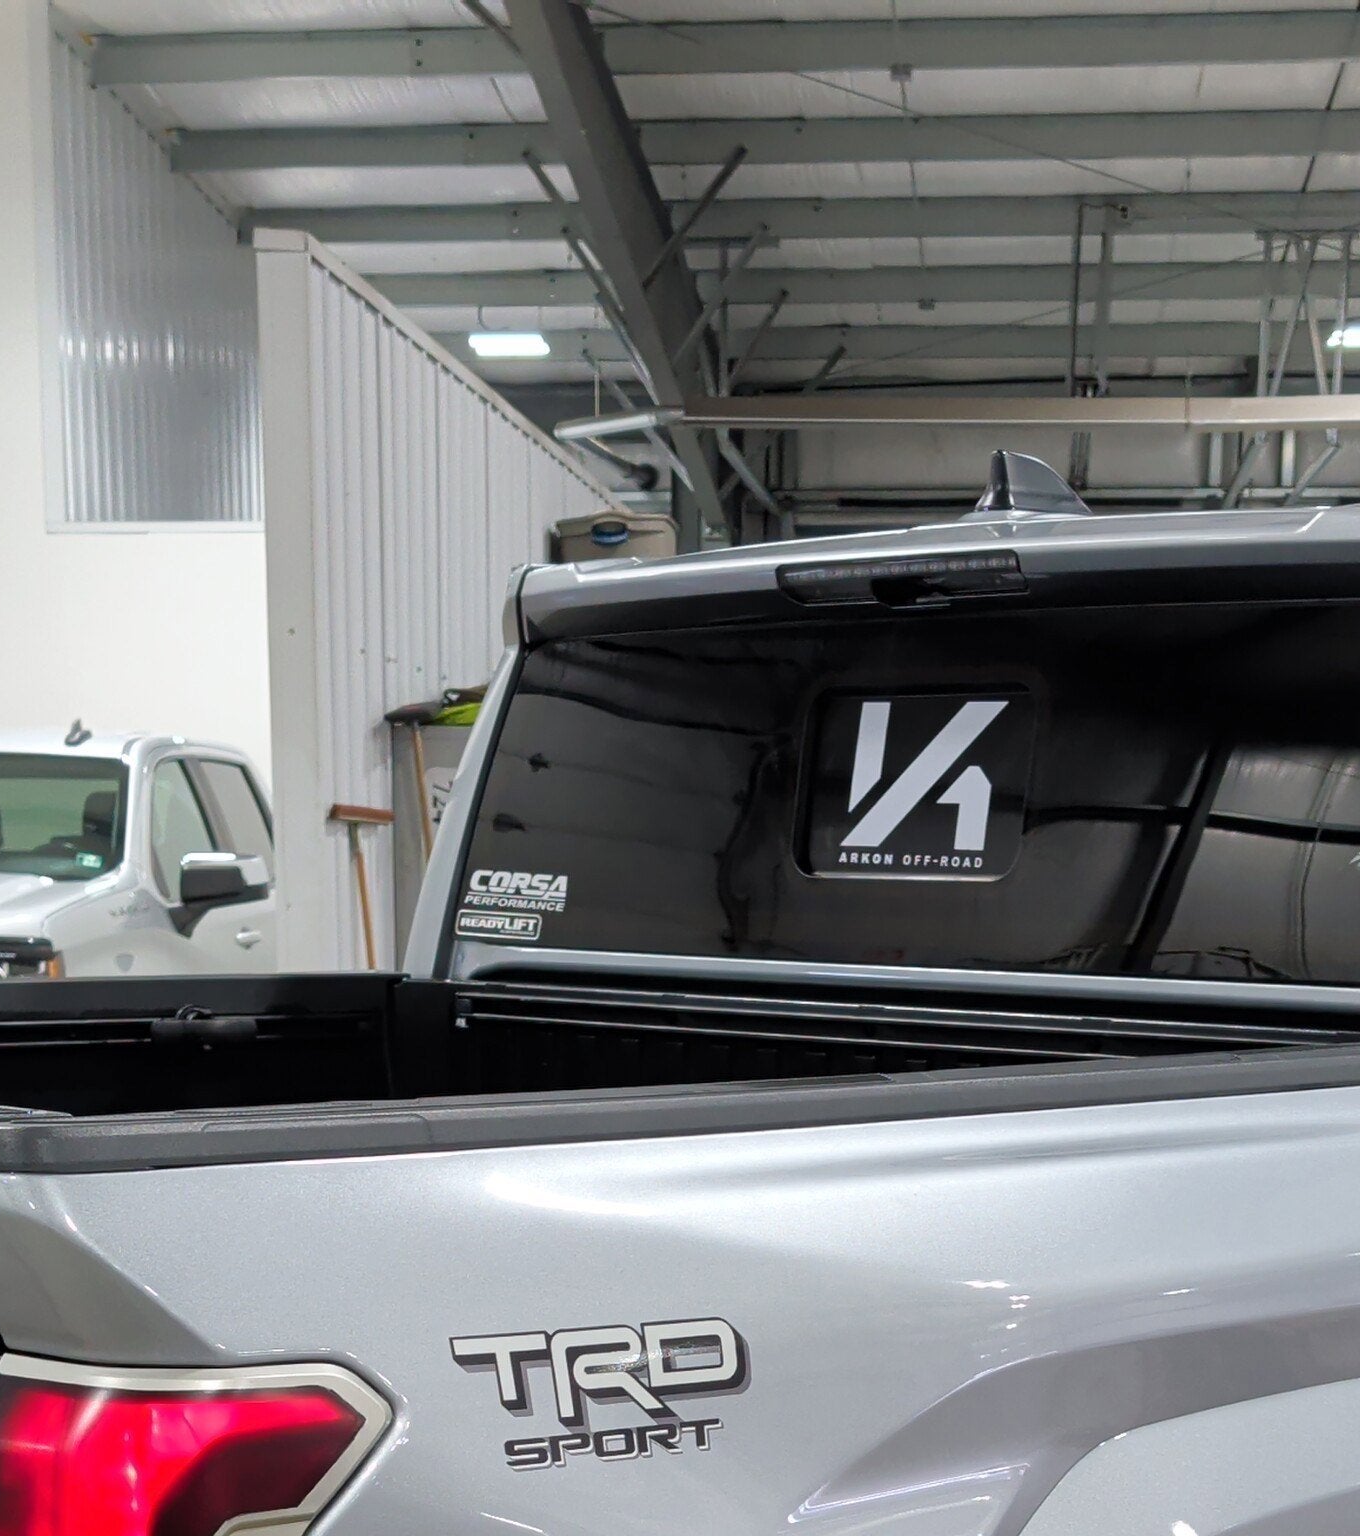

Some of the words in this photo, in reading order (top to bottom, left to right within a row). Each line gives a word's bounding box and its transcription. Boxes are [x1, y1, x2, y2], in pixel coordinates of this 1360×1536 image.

[838, 851, 893, 867] ARKON
[902, 854, 983, 868] OFF-ROAD
[469, 869, 568, 898] CORSA
[464, 895, 565, 912] PERFORMANCE
[449, 1316, 750, 1428] TRD
[504, 1418, 724, 1471] SPORT
